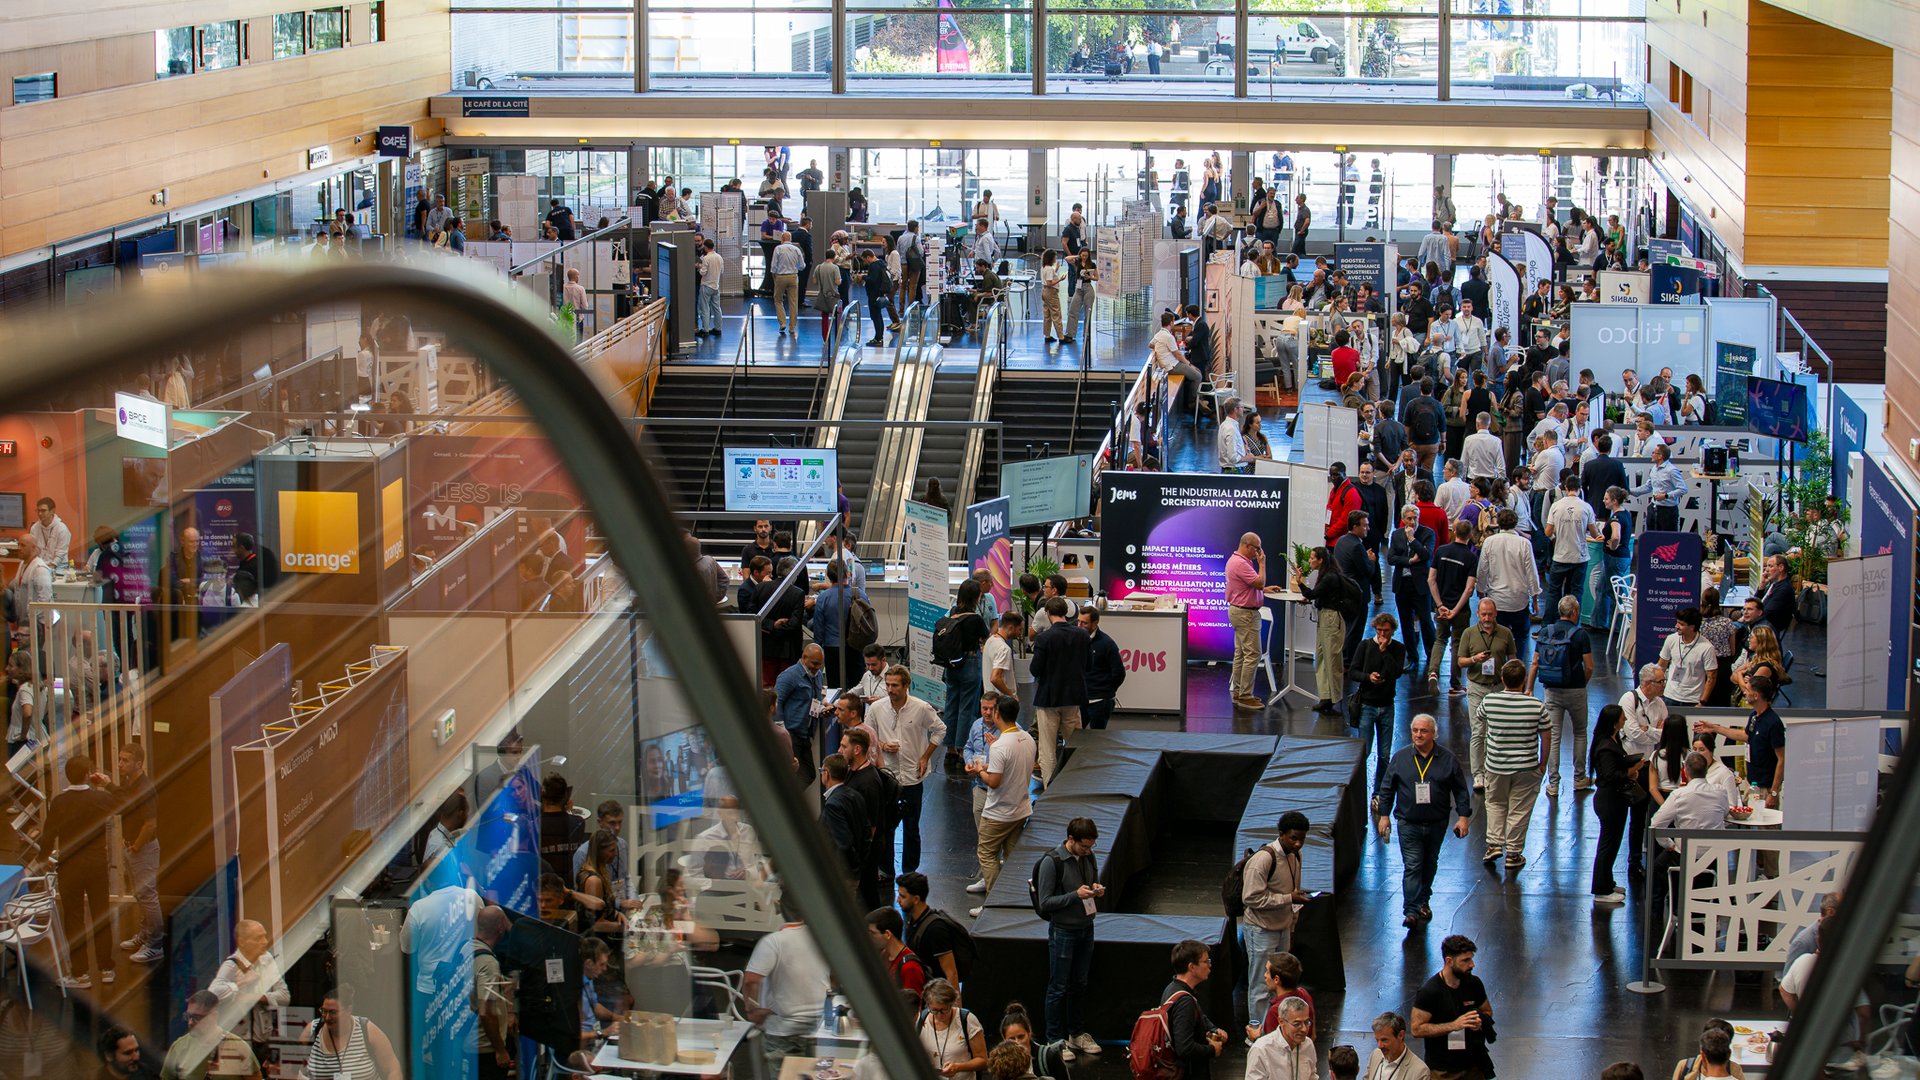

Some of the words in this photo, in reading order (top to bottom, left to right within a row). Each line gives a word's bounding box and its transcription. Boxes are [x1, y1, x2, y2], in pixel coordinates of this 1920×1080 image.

[473, 99, 491, 108] CAFÉ
[512, 99, 528, 107] CITÉ
[1611, 295, 1638, 304] SINBAD
[128, 410, 147, 424] BPCE
[432, 482, 490, 503] LESS
[500, 483, 523, 504] IS
[1110, 487, 1137, 503] Jems
[1161, 487, 1177, 496] THE
[1179, 488, 1233, 497] INDUSTRIAL
[1234, 489, 1258, 498] DATA
[1260, 490, 1269, 499] &
[1270, 490, 1281, 499] AI
[1161, 498, 1234, 508] ORCHESTRATION
[1235, 500, 1280, 509] COMPANY
[974, 511, 1003, 545] Jems
[384, 539, 403, 563] orange
[284, 552, 352, 571] orange
[1650, 556, 1659, 564] ia
[1141, 562, 1171, 570] USAGES
[1172, 561, 1202, 571] MÉTIERS
[1650, 563, 1693, 571] souveraine.fr
[1141, 579, 1214, 588] INDUSTRIALISATION
[1658, 596, 1693, 604] échappaient
[1653, 625, 1677, 633] Reprene
[1120, 648, 1167, 673] ems
[318, 727, 333, 749] AMD
